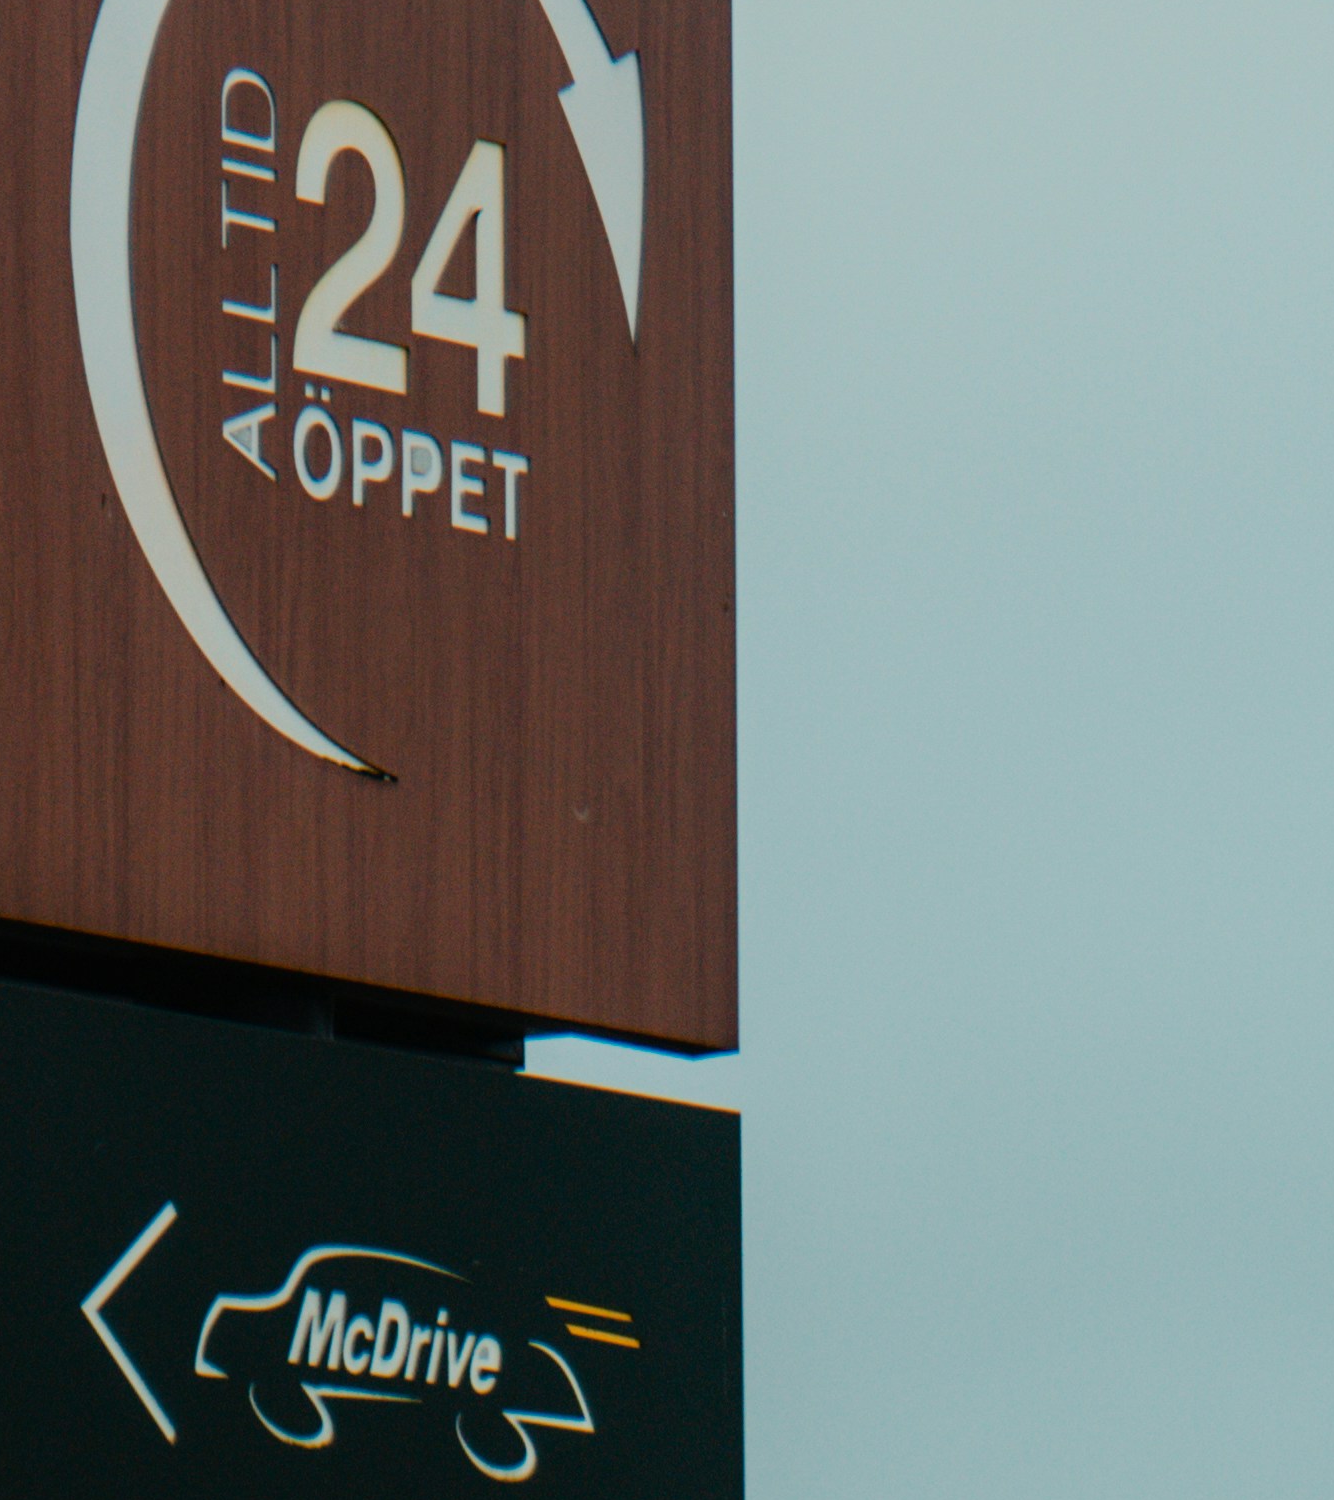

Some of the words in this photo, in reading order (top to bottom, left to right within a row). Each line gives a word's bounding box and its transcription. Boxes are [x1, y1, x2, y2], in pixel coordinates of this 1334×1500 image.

[293, 99, 528, 418] 24
[293, 382, 530, 541] ÖPPET
[287, 1287, 503, 1394] McDrive
